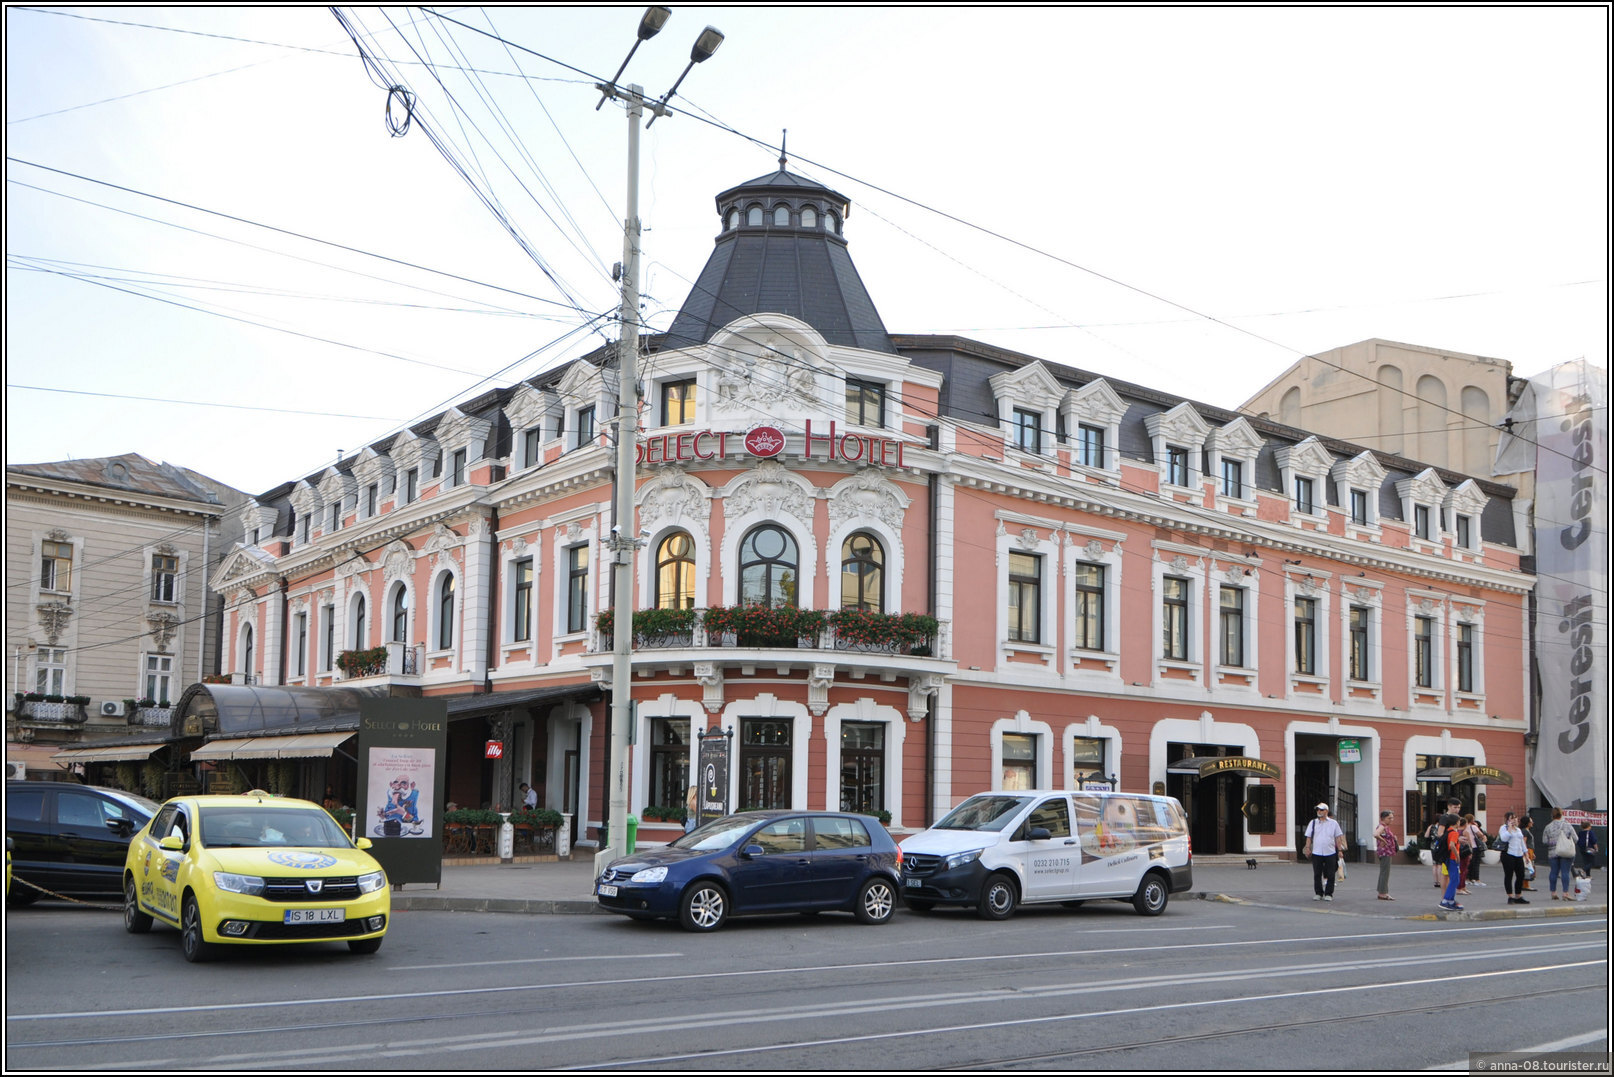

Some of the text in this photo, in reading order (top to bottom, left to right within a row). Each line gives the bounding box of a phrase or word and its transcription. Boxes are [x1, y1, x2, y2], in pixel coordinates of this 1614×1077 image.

[804, 418, 910, 469] HOTEL
[1560, 393, 1594, 551] Ceresit
[1558, 594, 1594, 755] Ceresit
[411, 719, 441, 731] HOTEL
[487, 744, 502, 757] illy
[1218, 759, 1268, 771] RESTAURANT
[1033, 857, 1070, 867] 0232 210 715
[291, 910, 339, 920] IS 18 LXL
